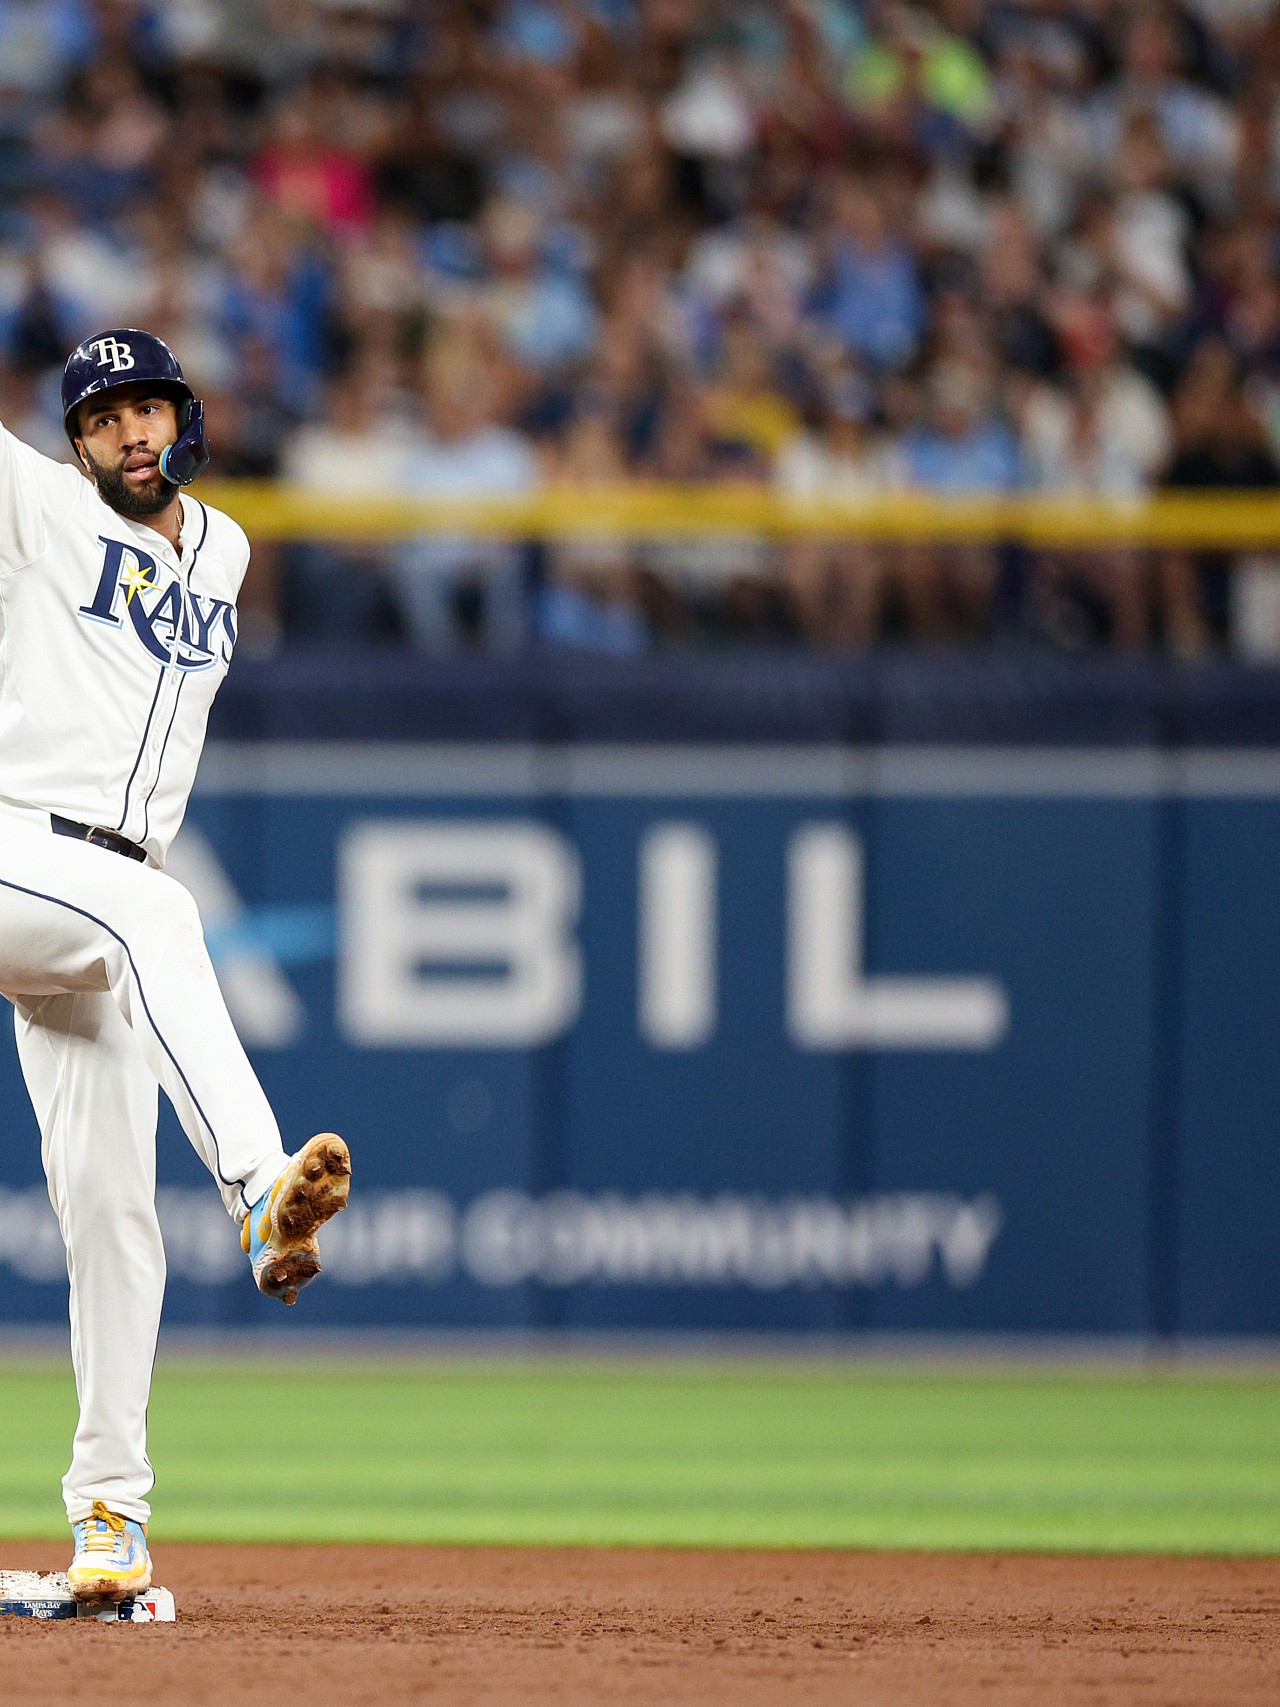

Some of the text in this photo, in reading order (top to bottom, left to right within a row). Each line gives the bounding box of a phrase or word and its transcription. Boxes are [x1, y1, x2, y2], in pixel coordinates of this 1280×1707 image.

[89, 336, 135, 373] TB
[76, 534, 238, 673] RAYS
[318, 1189, 457, 1283] UR
[462, 1190, 1003, 1287] COMMUNITY
[23, 1601, 61, 1609] TAMPA BAY
